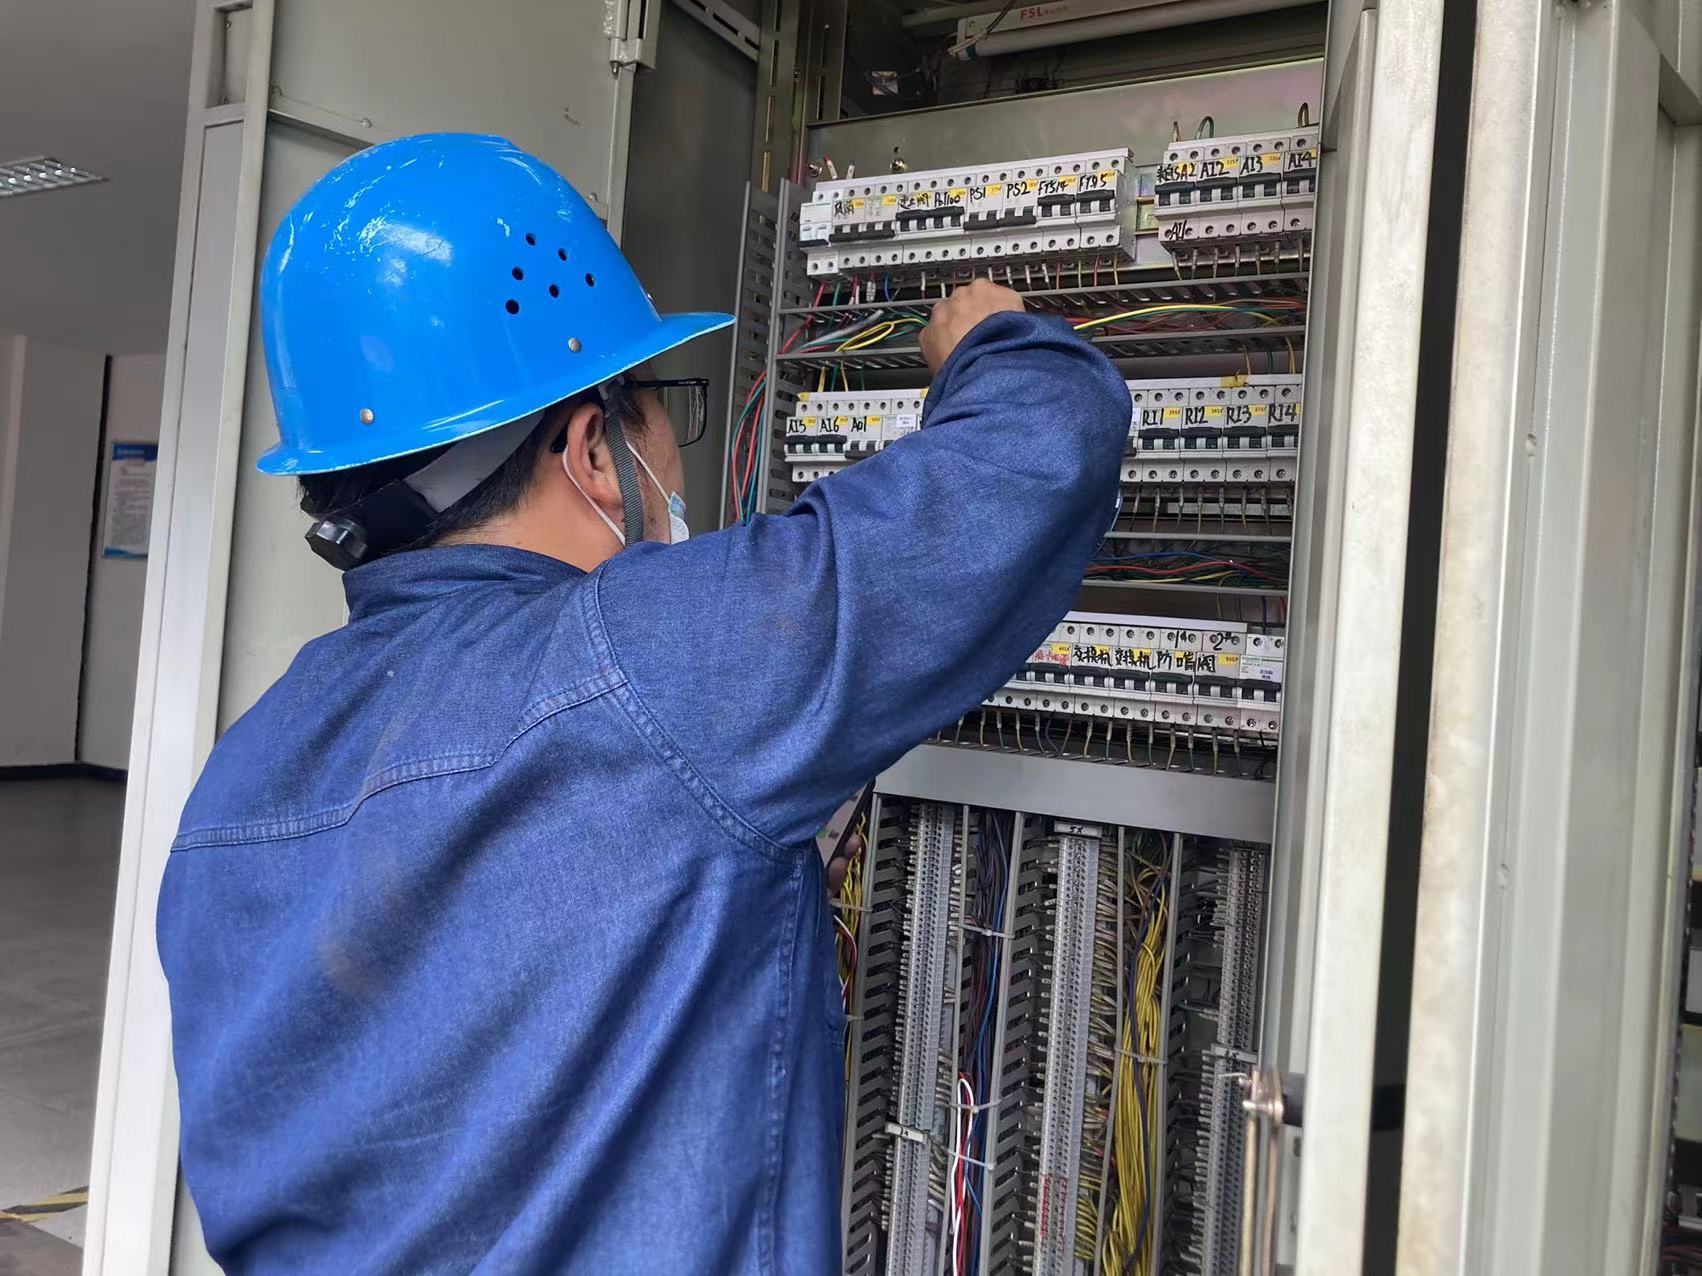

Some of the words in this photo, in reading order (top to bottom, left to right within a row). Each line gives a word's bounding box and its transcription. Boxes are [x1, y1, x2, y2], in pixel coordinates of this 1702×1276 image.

[1200, 160, 1230, 179] AI2
[1239, 156, 1264, 175] AI3
[1287, 151, 1317, 170] AI4
[969, 187, 986, 203] PS1
[1006, 181, 1031, 199] PS2
[1142, 407, 1164, 426] RI1
[1184, 406, 1209, 425] RI2
[1226, 405, 1253, 426] RI3
[1268, 403, 1298, 424] RI4
[787, 418, 807, 434] AI5
[819, 416, 840, 432] AI6
[1072, 644, 1113, 667] 交换机
[1114, 647, 1157, 671] 交换机
